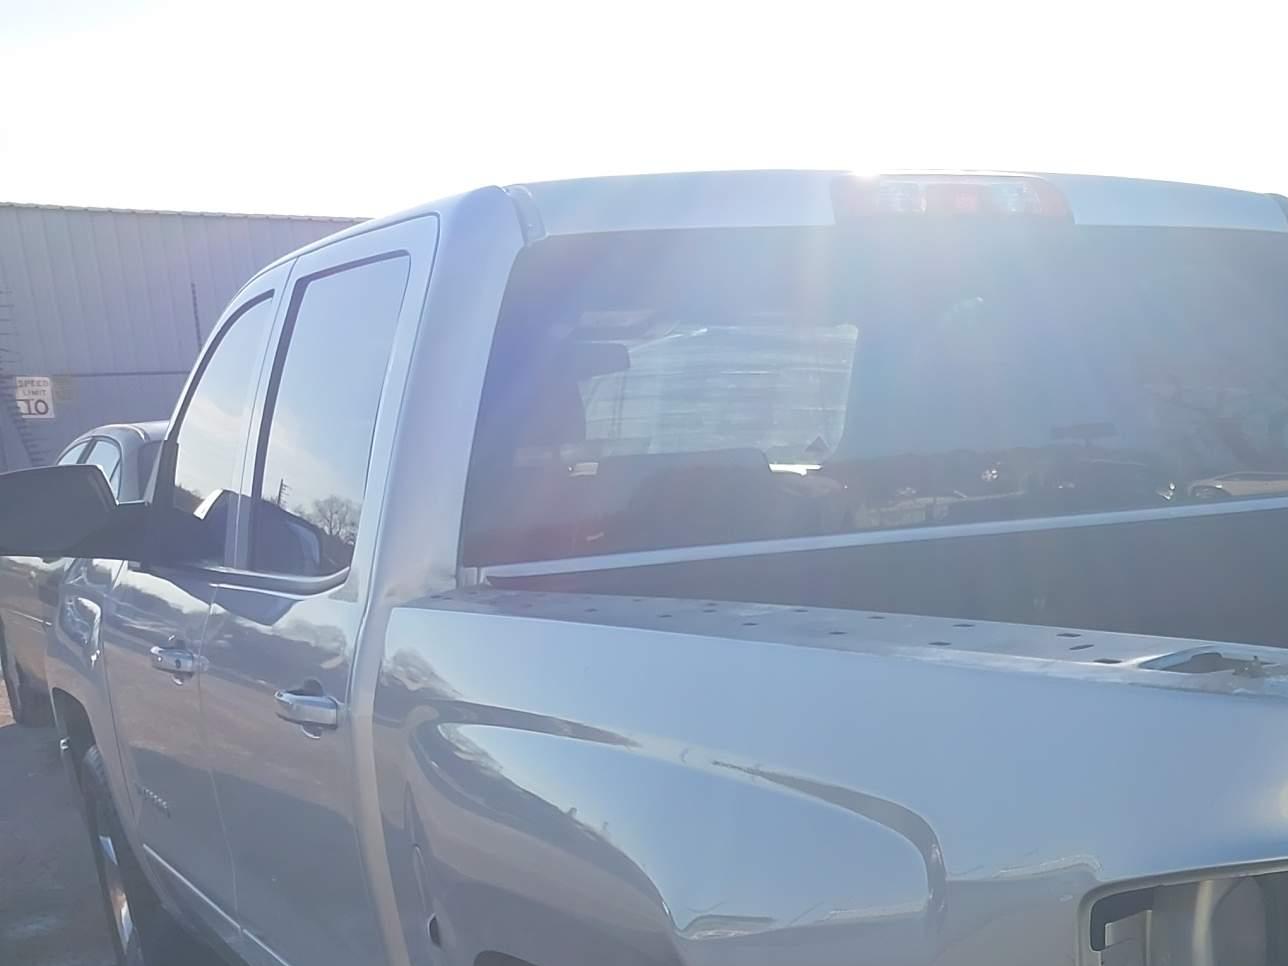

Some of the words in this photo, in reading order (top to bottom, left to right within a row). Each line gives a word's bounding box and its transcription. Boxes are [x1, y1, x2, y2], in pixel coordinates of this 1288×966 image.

[17, 379, 49, 388] SPEED
[23, 389, 48, 397] LIMIT
[26, 398, 49, 416] 10
